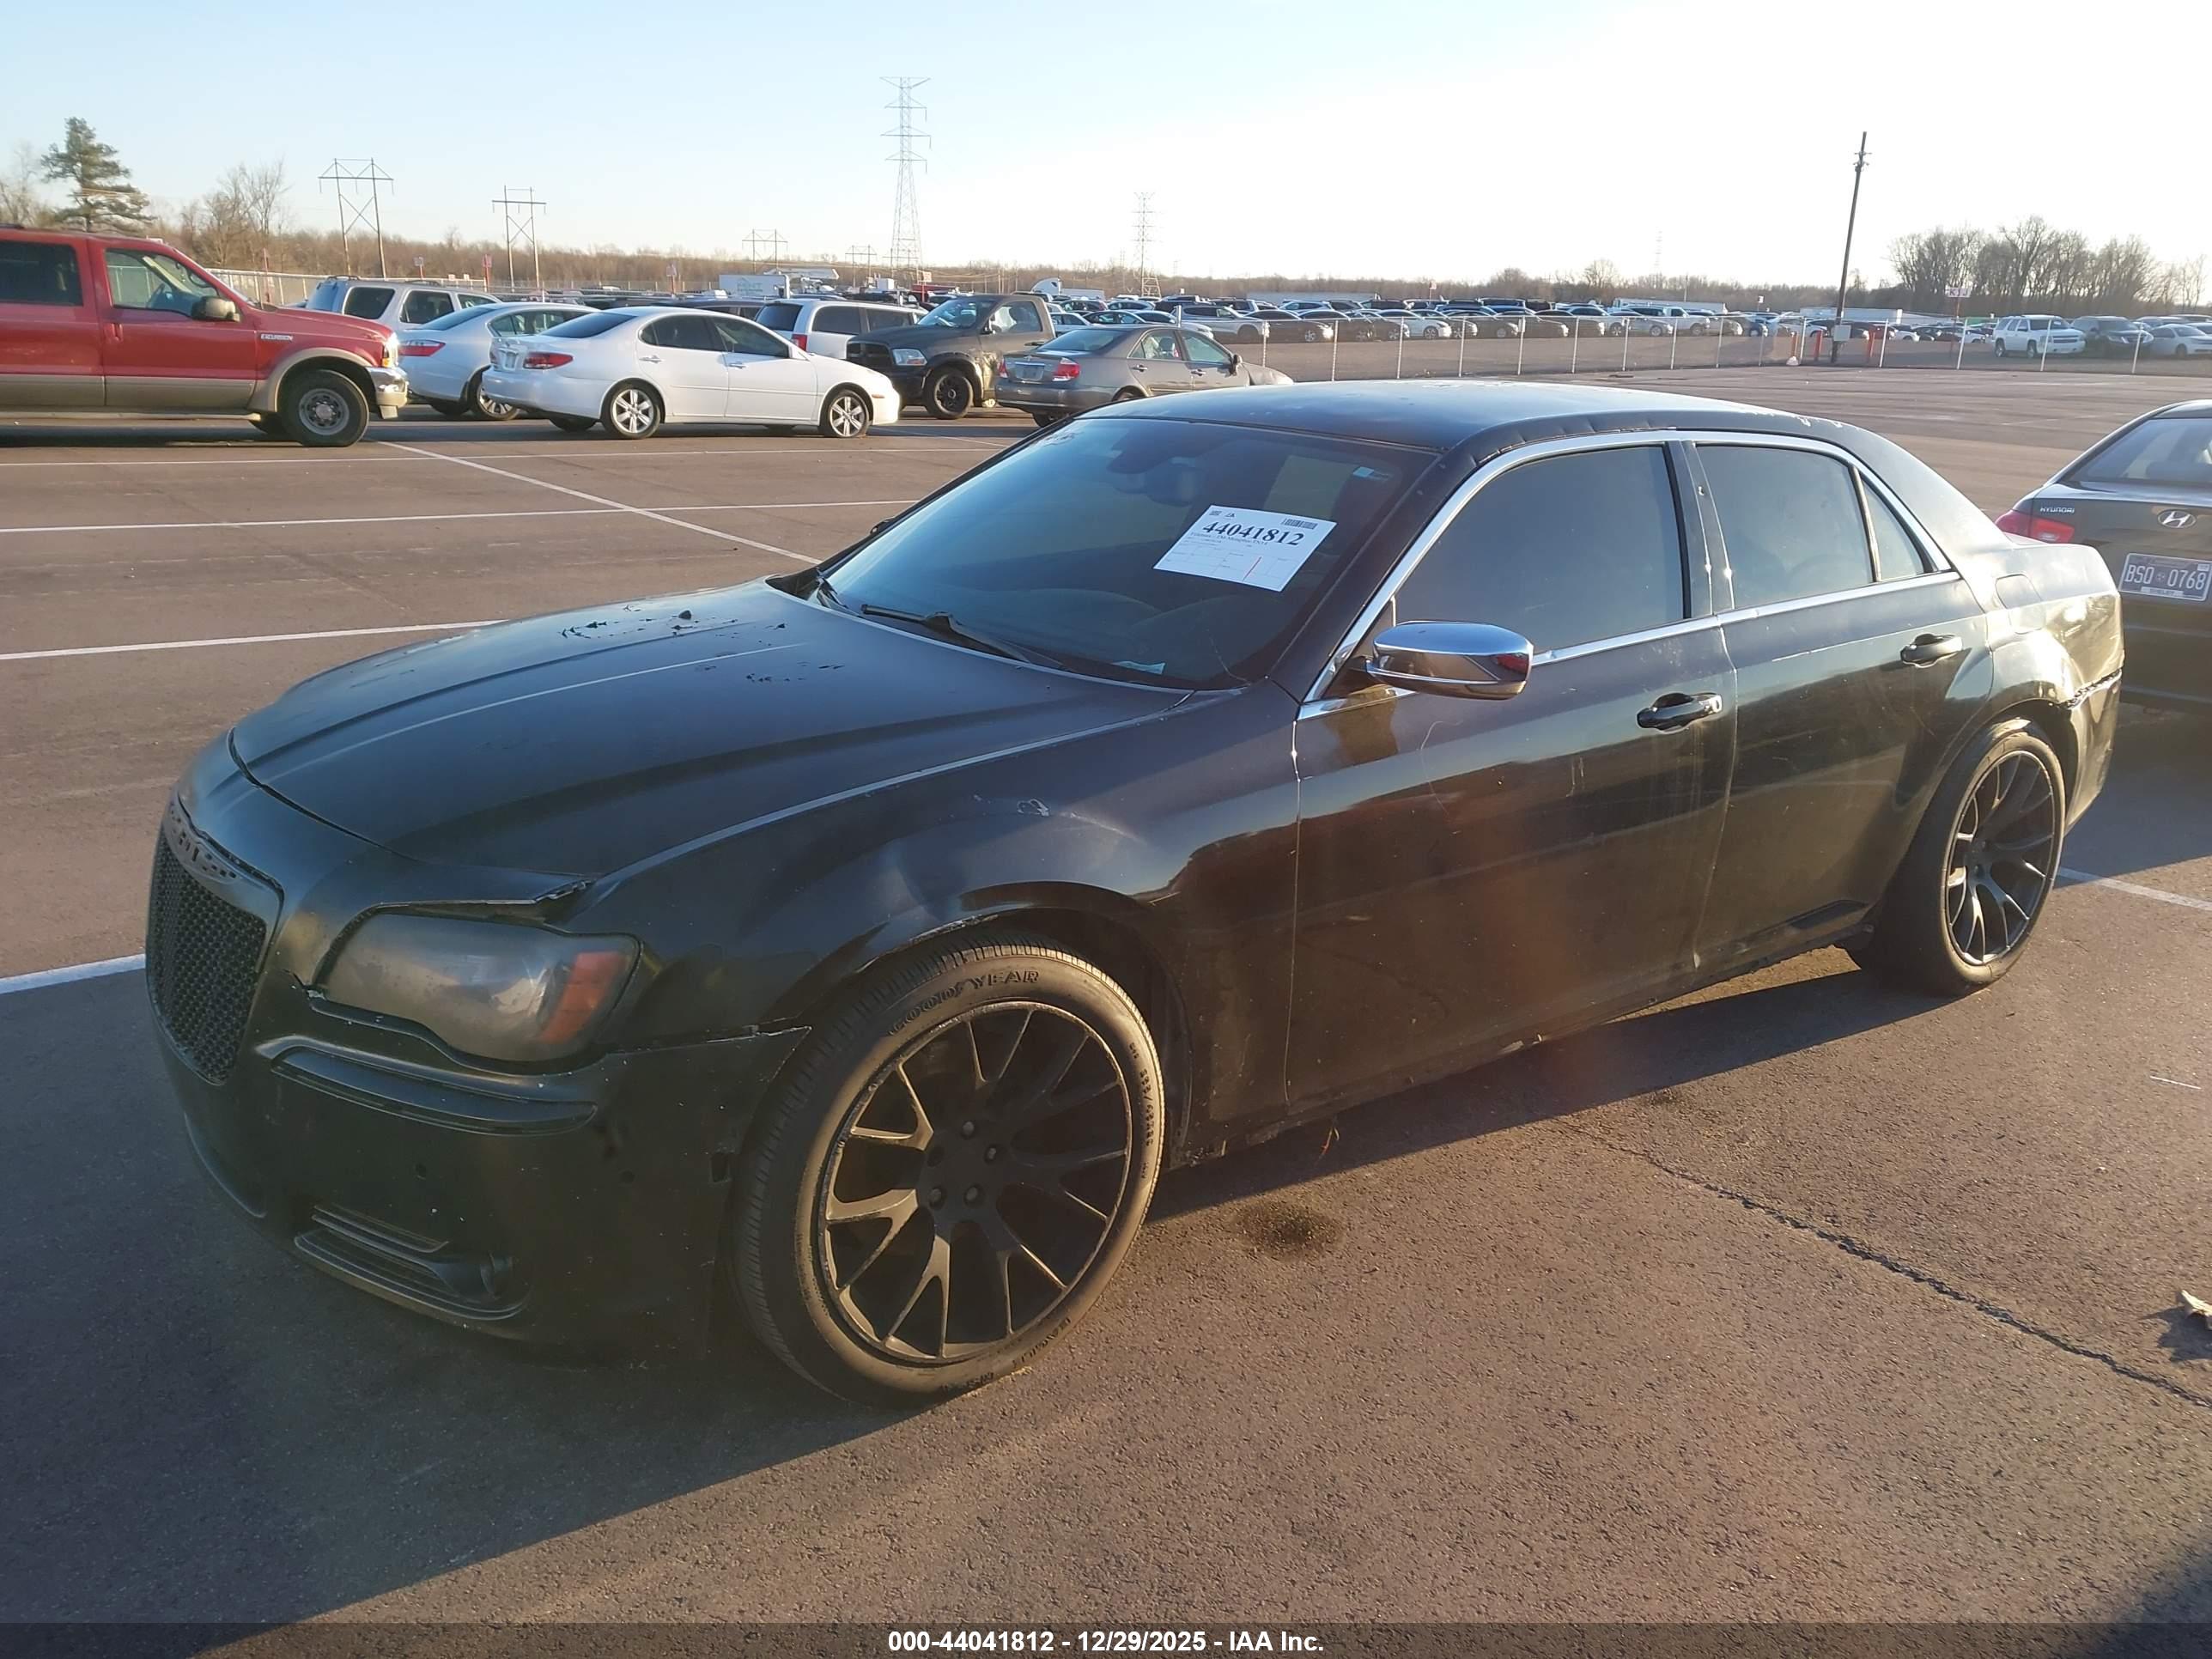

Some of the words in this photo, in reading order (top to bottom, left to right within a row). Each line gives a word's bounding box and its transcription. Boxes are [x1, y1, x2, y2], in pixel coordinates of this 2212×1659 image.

[2039, 506, 2075, 514] HYUNDAI
[1202, 520, 1304, 546] 44041812
[2167, 568, 2207, 591] 0768
